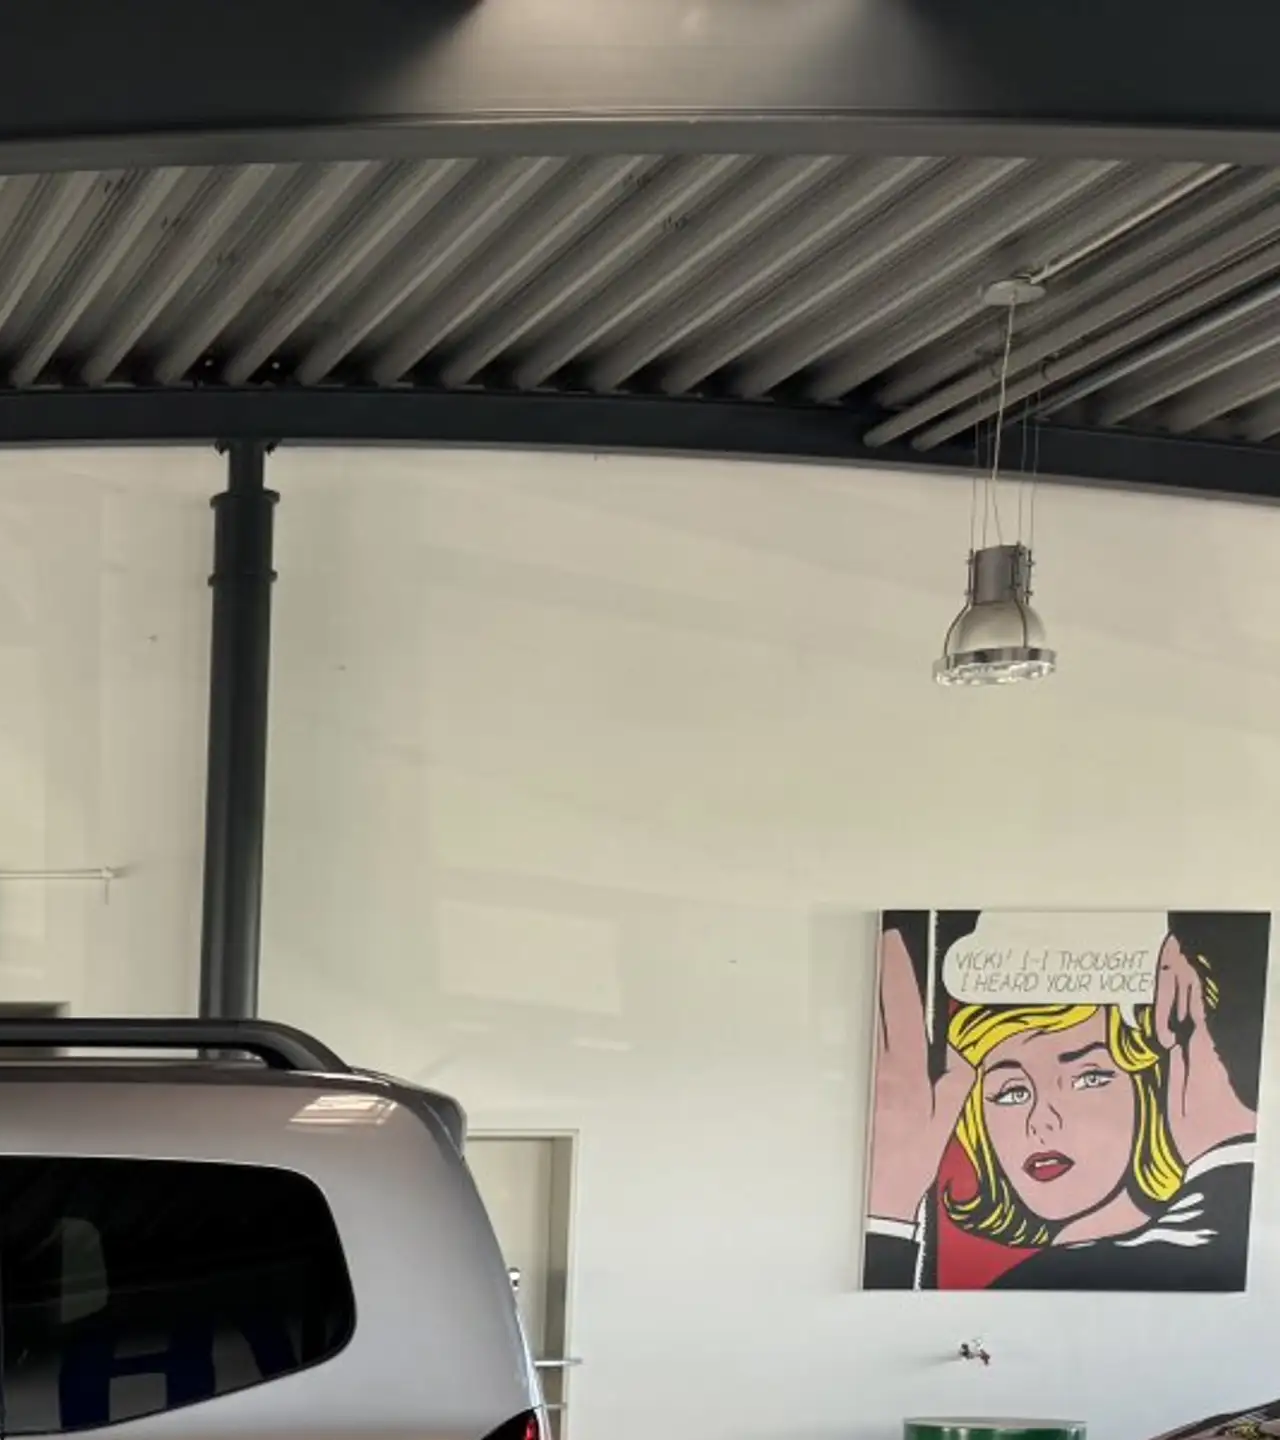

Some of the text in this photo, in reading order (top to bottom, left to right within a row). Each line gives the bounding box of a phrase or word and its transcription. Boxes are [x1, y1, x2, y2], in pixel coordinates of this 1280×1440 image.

[1057, 949, 1150, 971] THOUGHT
[960, 971, 970, 993] I
[973, 971, 1039, 993] HEARD
[1046, 971, 1092, 993] YOUR
